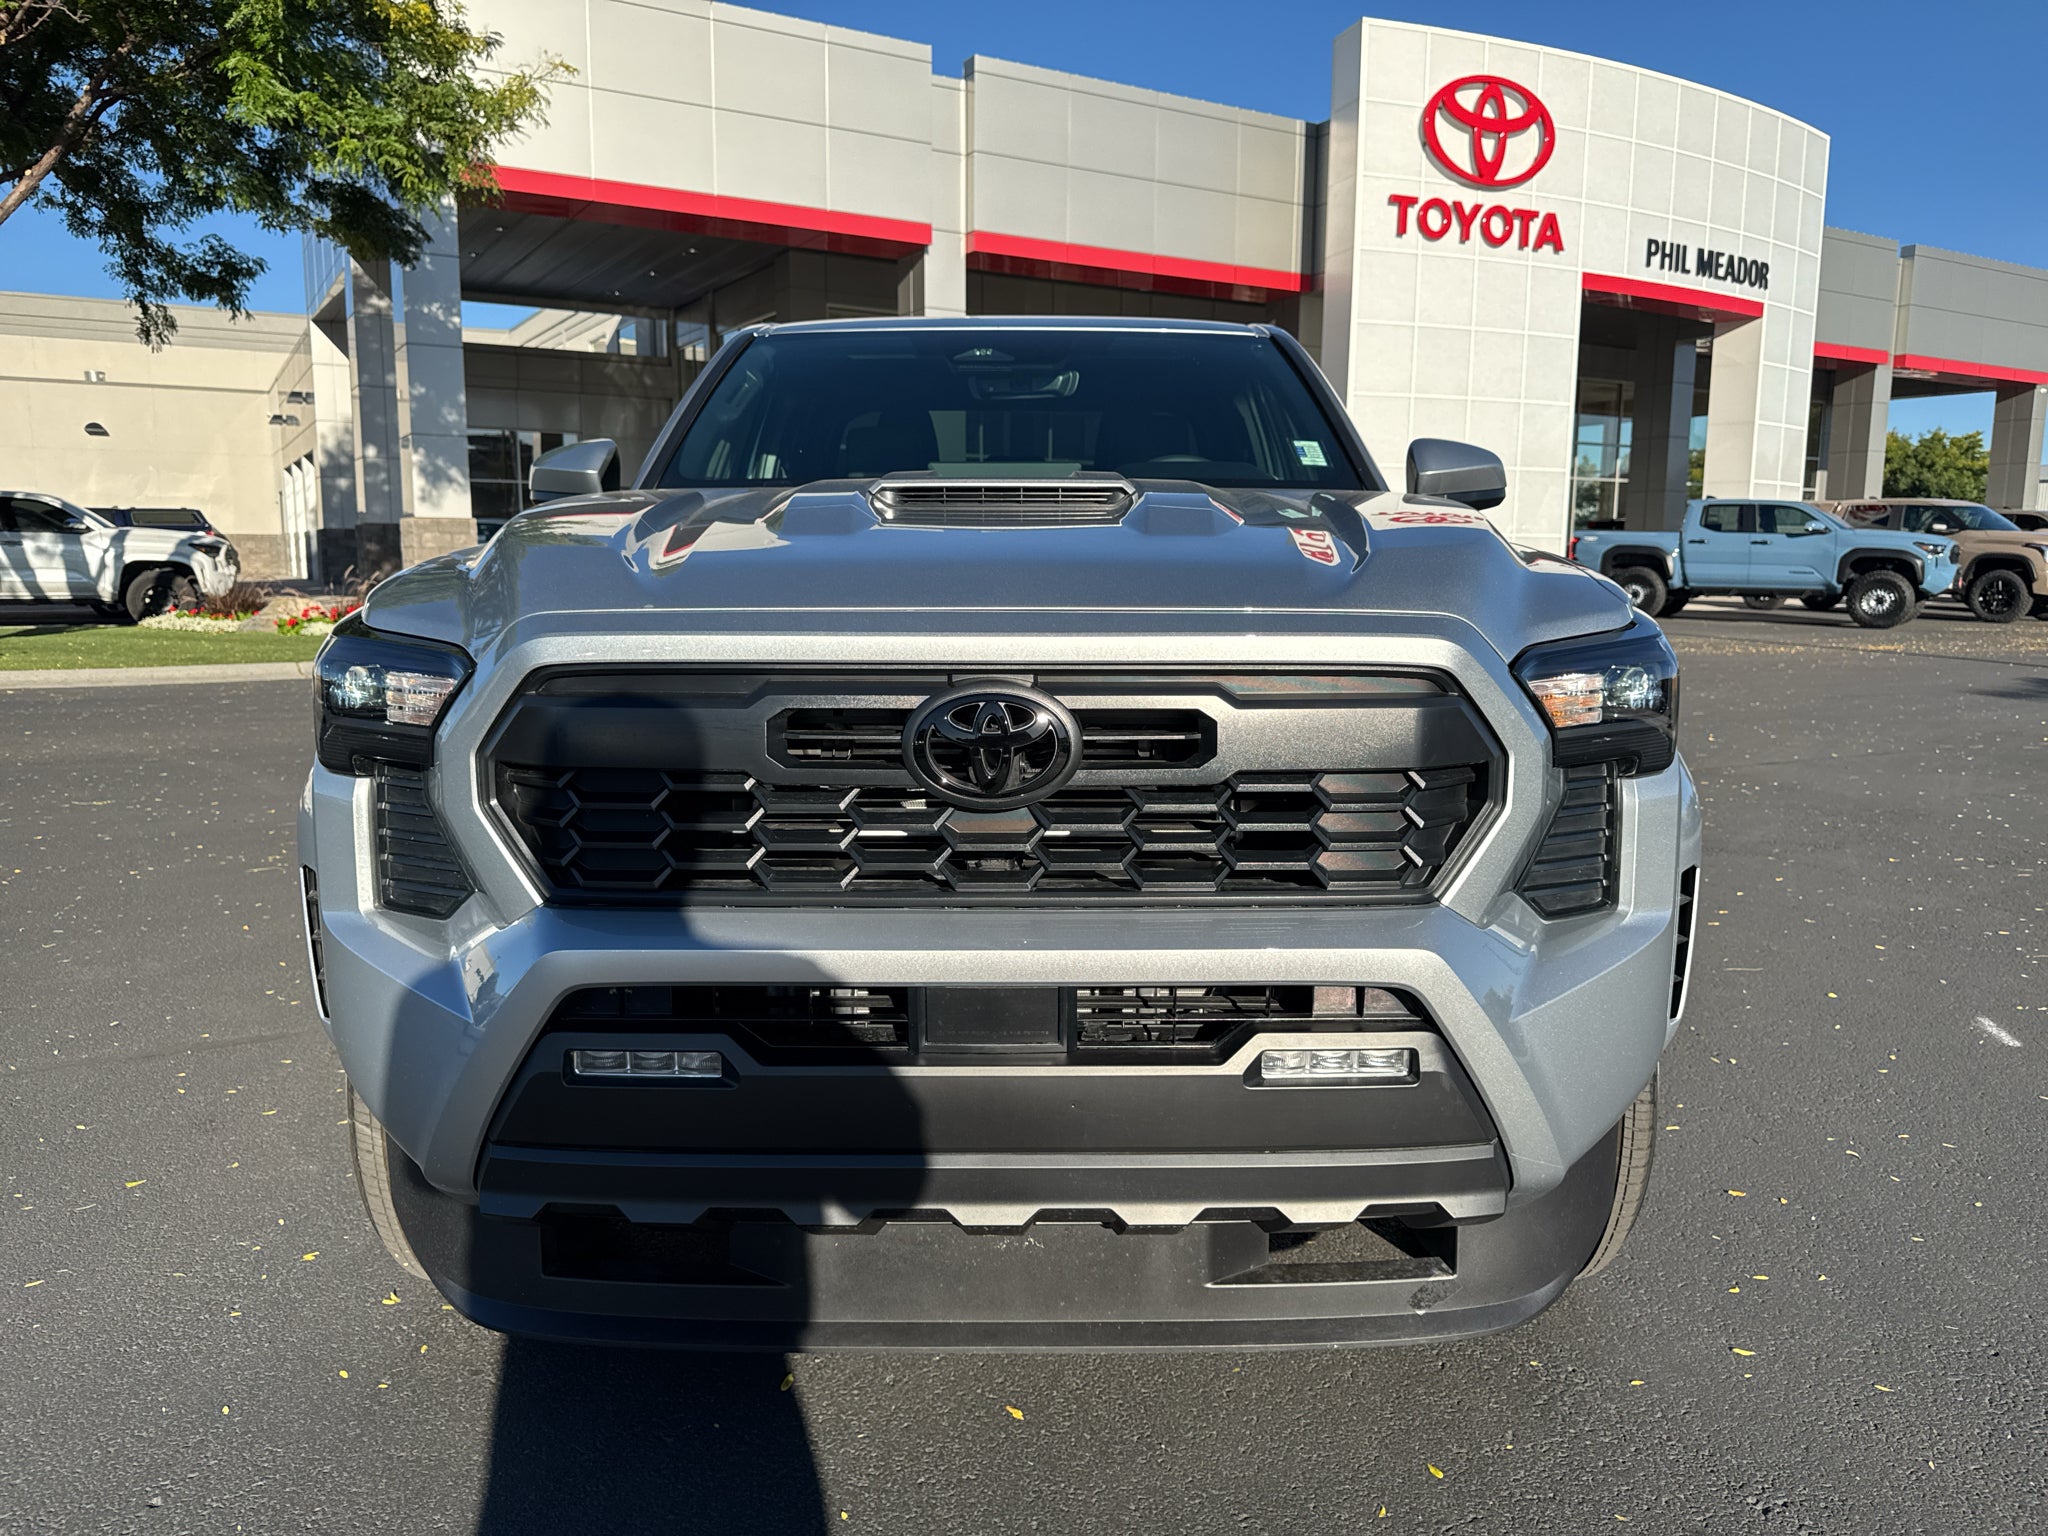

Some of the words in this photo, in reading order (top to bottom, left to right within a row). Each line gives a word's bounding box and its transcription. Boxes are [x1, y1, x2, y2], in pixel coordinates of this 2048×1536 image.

[1388, 194, 1565, 254] TOYOTA
[1645, 238, 1691, 275] PHIL
[1695, 247, 1770, 291] MEADOR
